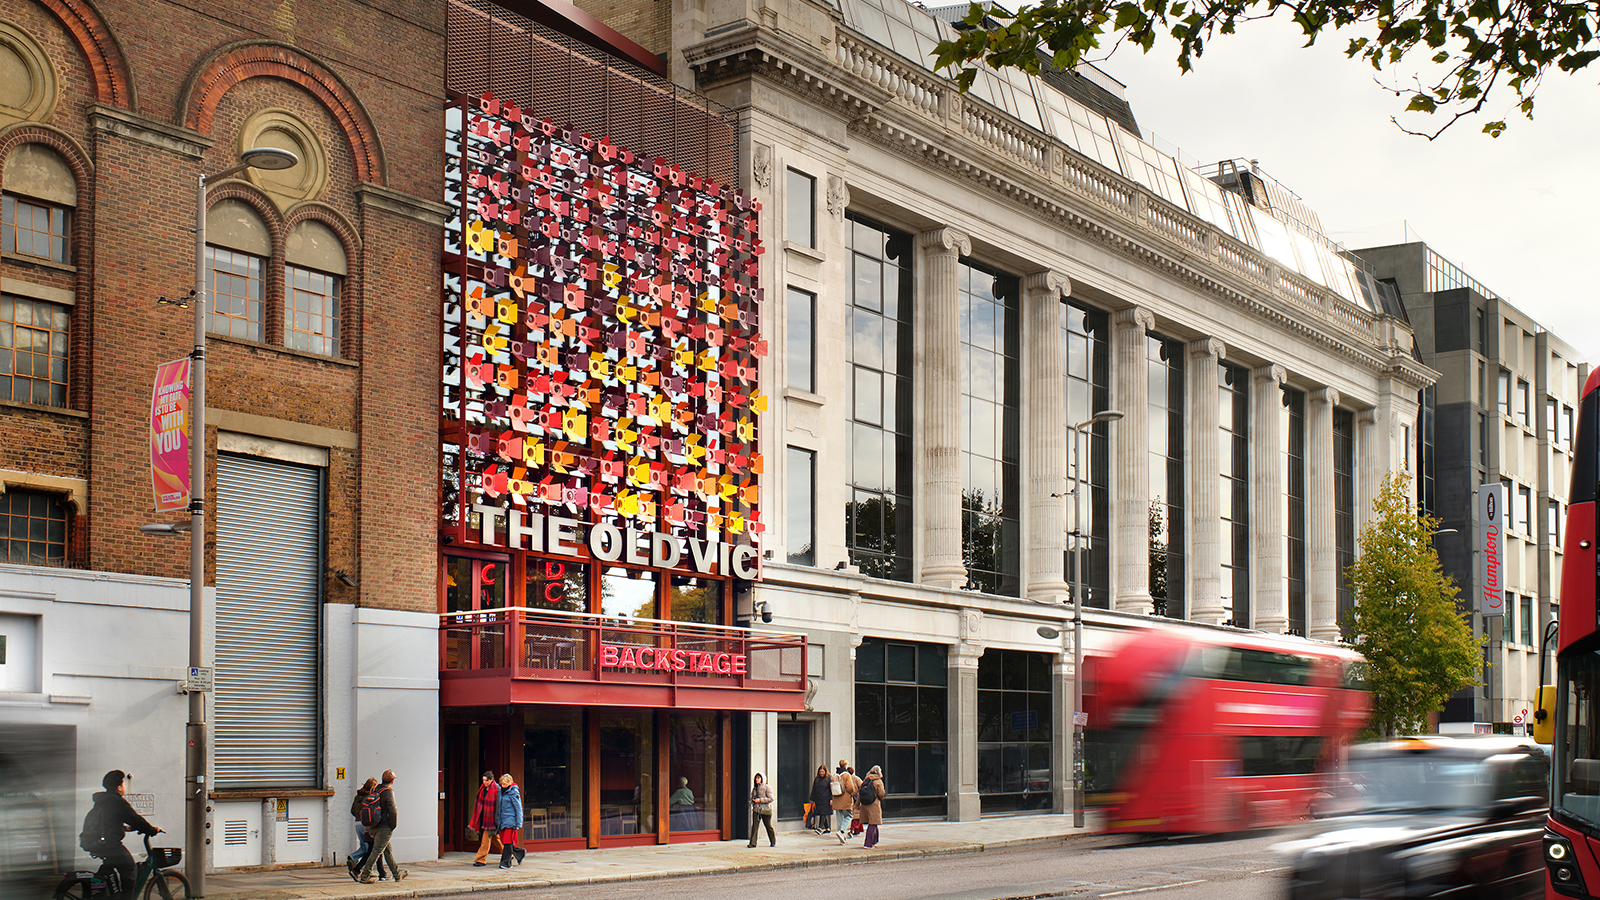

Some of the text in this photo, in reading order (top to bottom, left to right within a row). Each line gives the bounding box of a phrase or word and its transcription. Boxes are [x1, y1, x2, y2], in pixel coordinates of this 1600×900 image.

[158, 380, 184, 396] KNOWING
[160, 391, 182, 405] MY FATE
[155, 402, 177, 416] IS TO BE
[161, 409, 184, 430] WITH
[156, 427, 182, 455] YOU
[472, 503, 759, 580] THE OLD VIC
[1482, 525, 1503, 609] Hampton
[600, 645, 748, 675] BACKSTAGE
[336, 767, 345, 780] H
